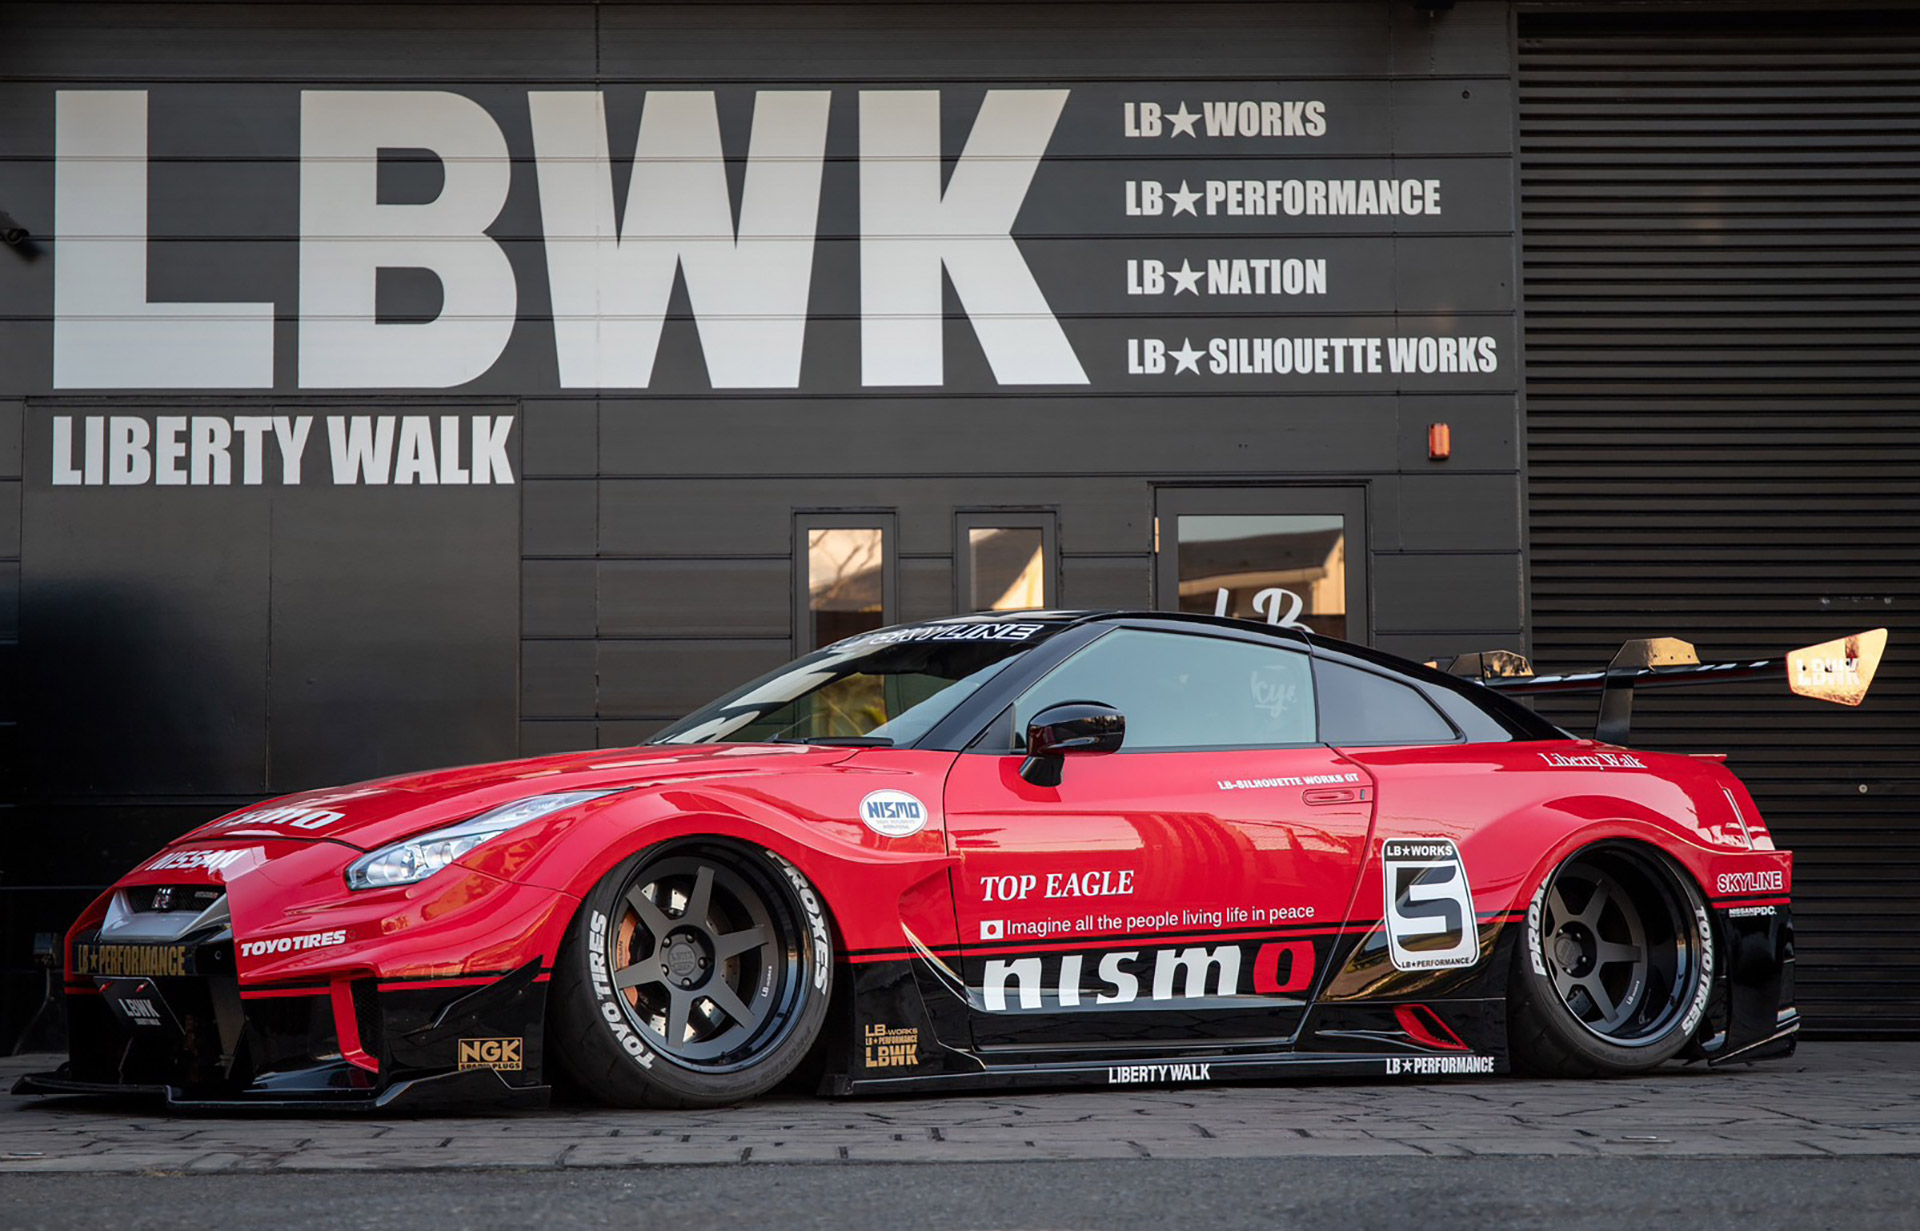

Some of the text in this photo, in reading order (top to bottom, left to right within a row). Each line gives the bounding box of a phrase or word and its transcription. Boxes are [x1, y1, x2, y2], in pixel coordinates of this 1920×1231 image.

[53, 90, 1090, 389] LBWK
[1387, 336, 1498, 373] WORKS
[52, 415, 515, 485] LIBERTY WALK
[1797, 658, 1861, 686] LBWK
[1537, 753, 1648, 771] Liberty Walk
[1302, 774, 1345, 785] WORKS
[1344, 773, 1360, 783] GT
[867, 801, 920, 818] NISMO
[145, 850, 249, 871] NISSAN
[980, 870, 1135, 901] TOP EAGLE
[1717, 871, 1783, 893] SKYLINE
[1007, 905, 1315, 937] Imagine all the people living life in peace
[1395, 865, 1463, 952] 5
[766, 849, 828, 996] PROXES
[983, 940, 1316, 1011] nismo
[118, 998, 161, 1017] LBWK
[461, 1040, 520, 1062] NGK
[865, 1044, 919, 1068] LBWK
[1108, 1063, 1211, 1084] LIBERTY WALK
